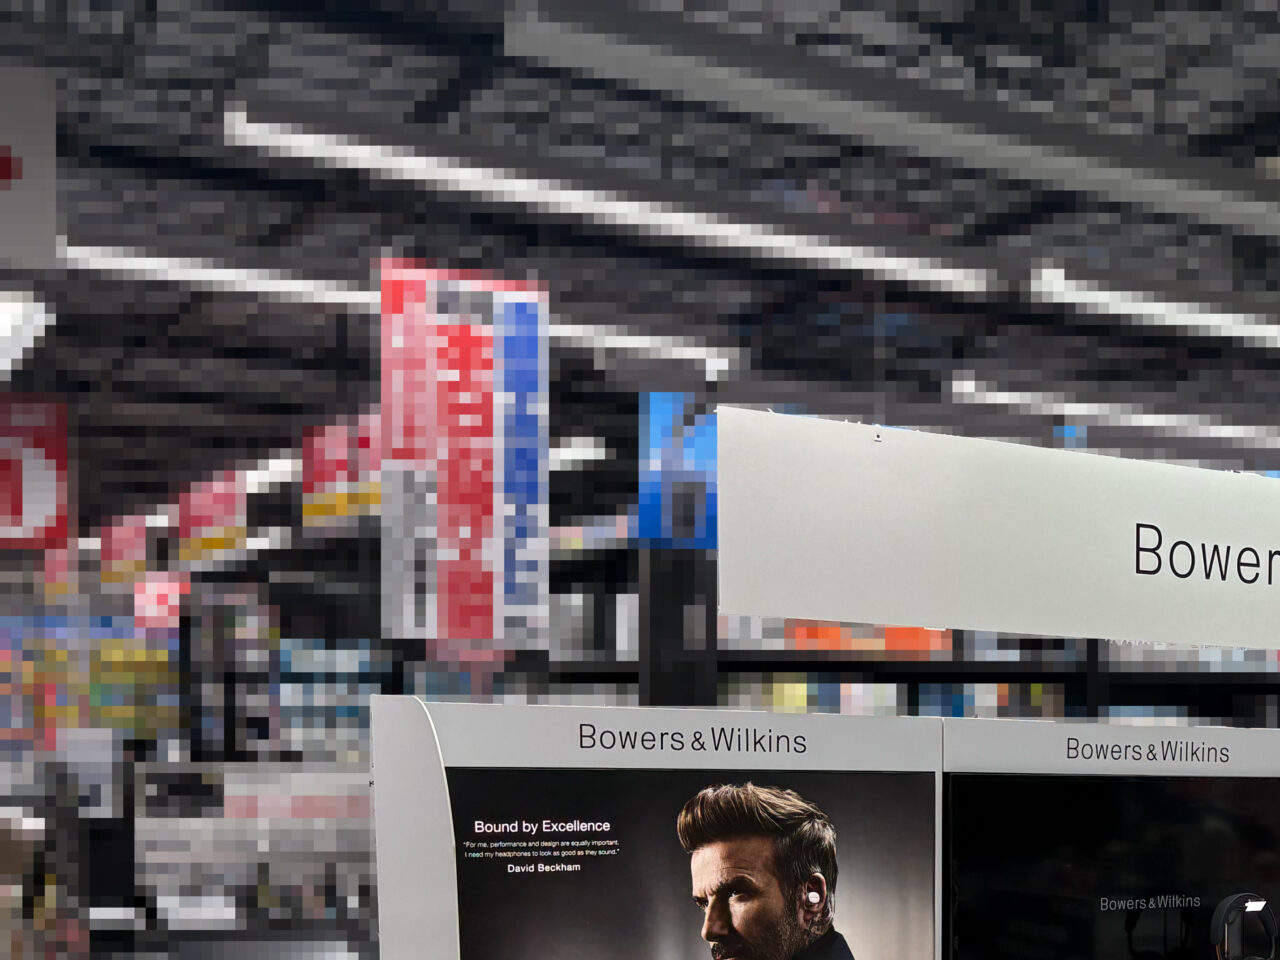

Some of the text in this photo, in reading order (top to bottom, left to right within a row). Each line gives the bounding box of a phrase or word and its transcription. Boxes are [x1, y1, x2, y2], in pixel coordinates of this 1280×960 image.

[579, 723, 807, 754] Bowers & Wilkins
[1066, 737, 1230, 763] Bowers & Wilkins
[474, 819, 611, 836] Bound by Excellence
[489, 841, 527, 849] performance
[528, 840, 540, 848] and
[540, 840, 560, 849] design
[570, 840, 591, 849] equally
[468, 850, 484, 858] need
[484, 852, 494, 860] my
[495, 850, 532, 859] headphones
[539, 849, 552, 857] look
[561, 849, 576, 859] good
[585, 849, 598, 858] they
[507, 862, 581, 873] David Beckham
[1100, 897, 1147, 911] Bowers
[1158, 894, 1201, 909] Wilkins
